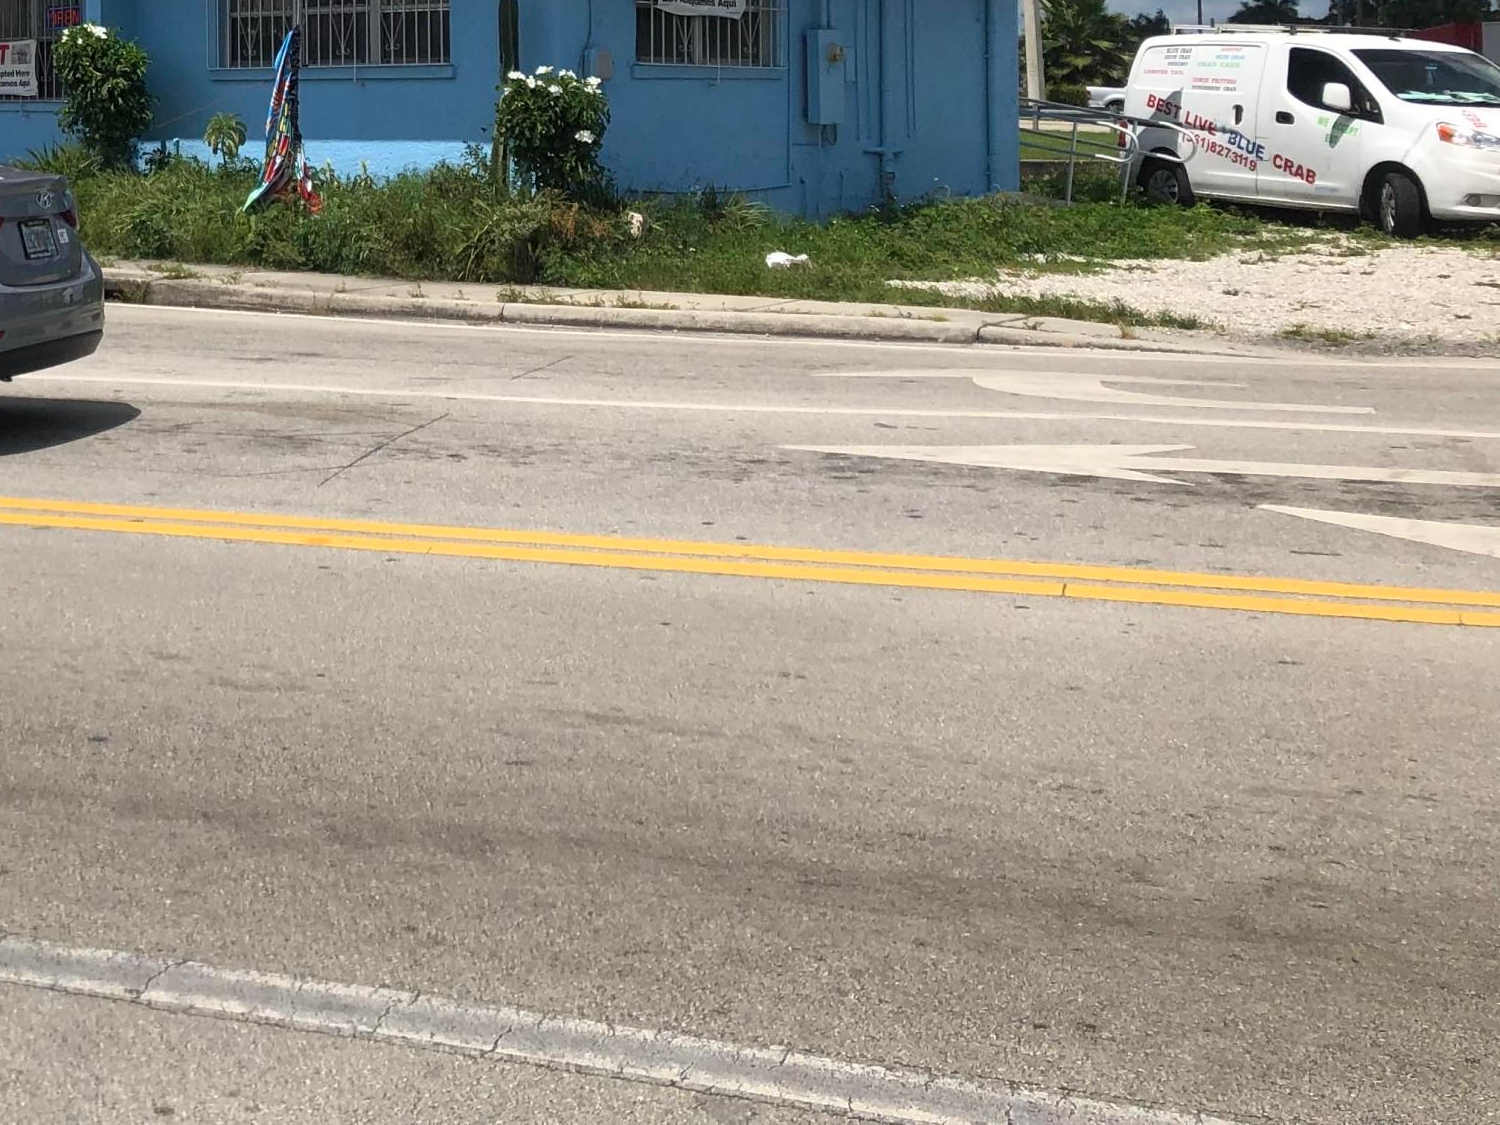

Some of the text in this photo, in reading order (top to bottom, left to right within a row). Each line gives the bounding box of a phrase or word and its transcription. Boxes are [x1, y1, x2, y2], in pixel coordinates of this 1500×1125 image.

[1146, 93, 1316, 185] BEST LIVE BLUE CRAB
